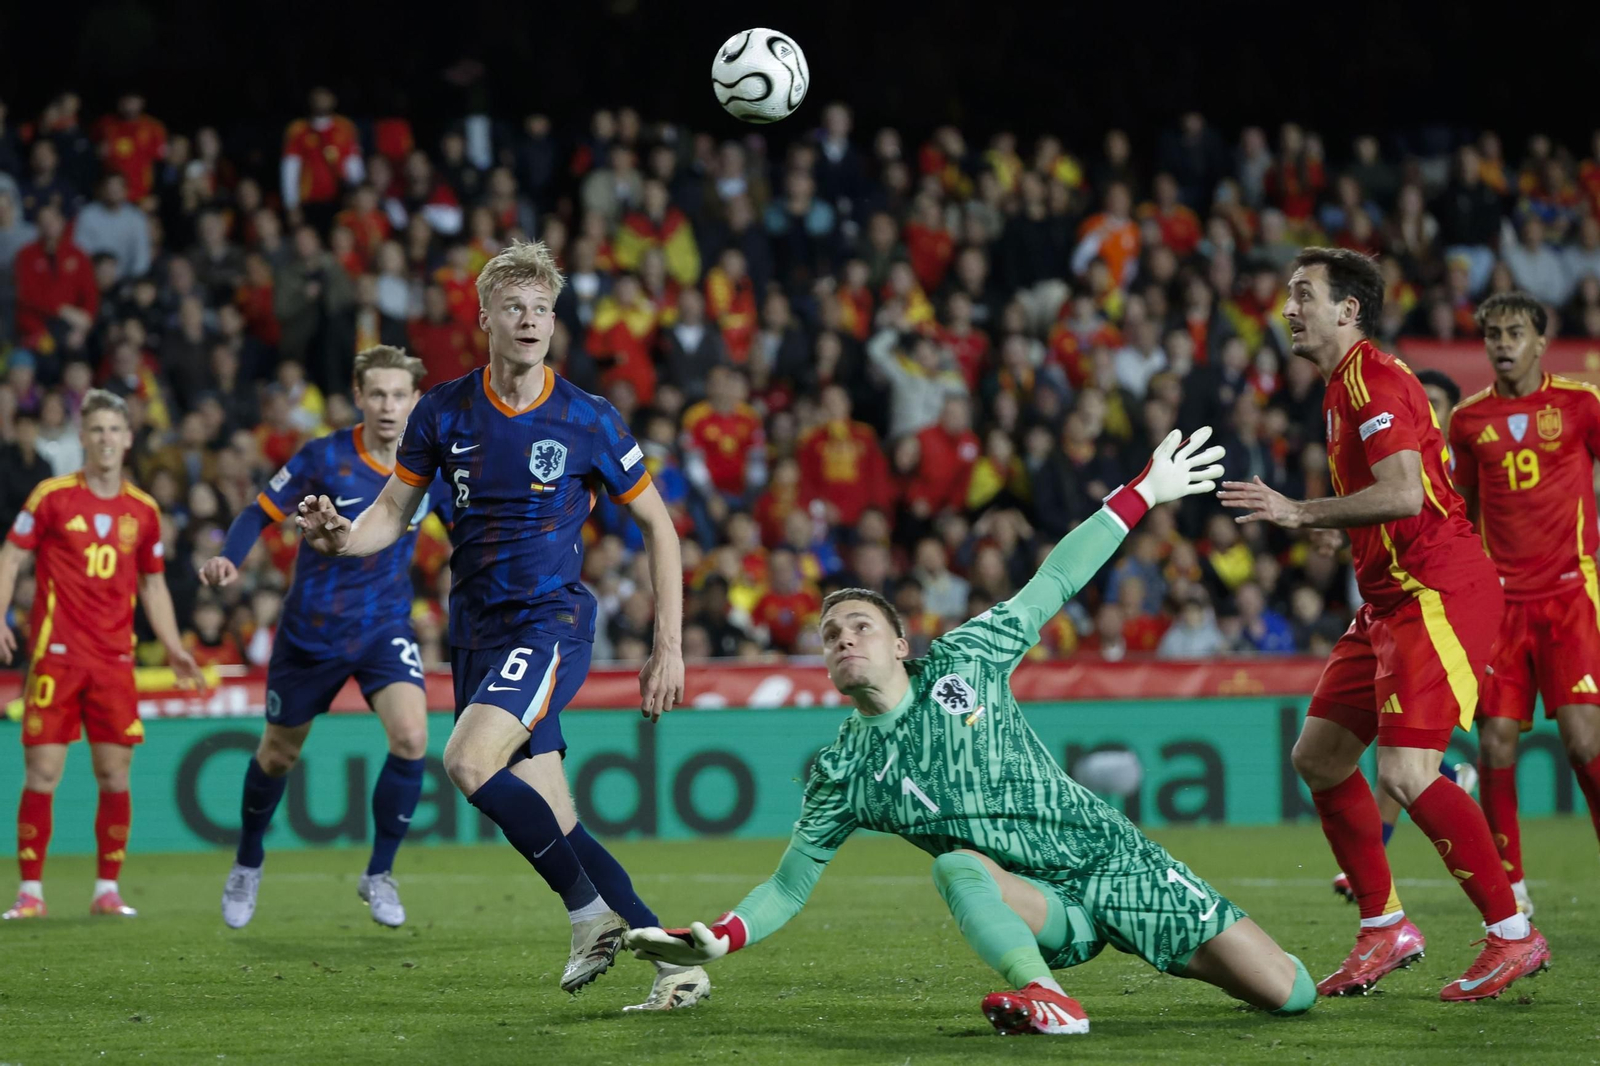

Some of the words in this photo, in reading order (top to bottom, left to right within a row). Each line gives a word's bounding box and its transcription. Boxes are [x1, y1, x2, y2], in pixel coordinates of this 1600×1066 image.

[1501, 448, 1540, 490] 19
[453, 468, 470, 508] 6
[84, 542, 117, 579] 10
[500, 647, 533, 681] 6
[902, 776, 939, 814] 1
[1166, 867, 1207, 899] 1
